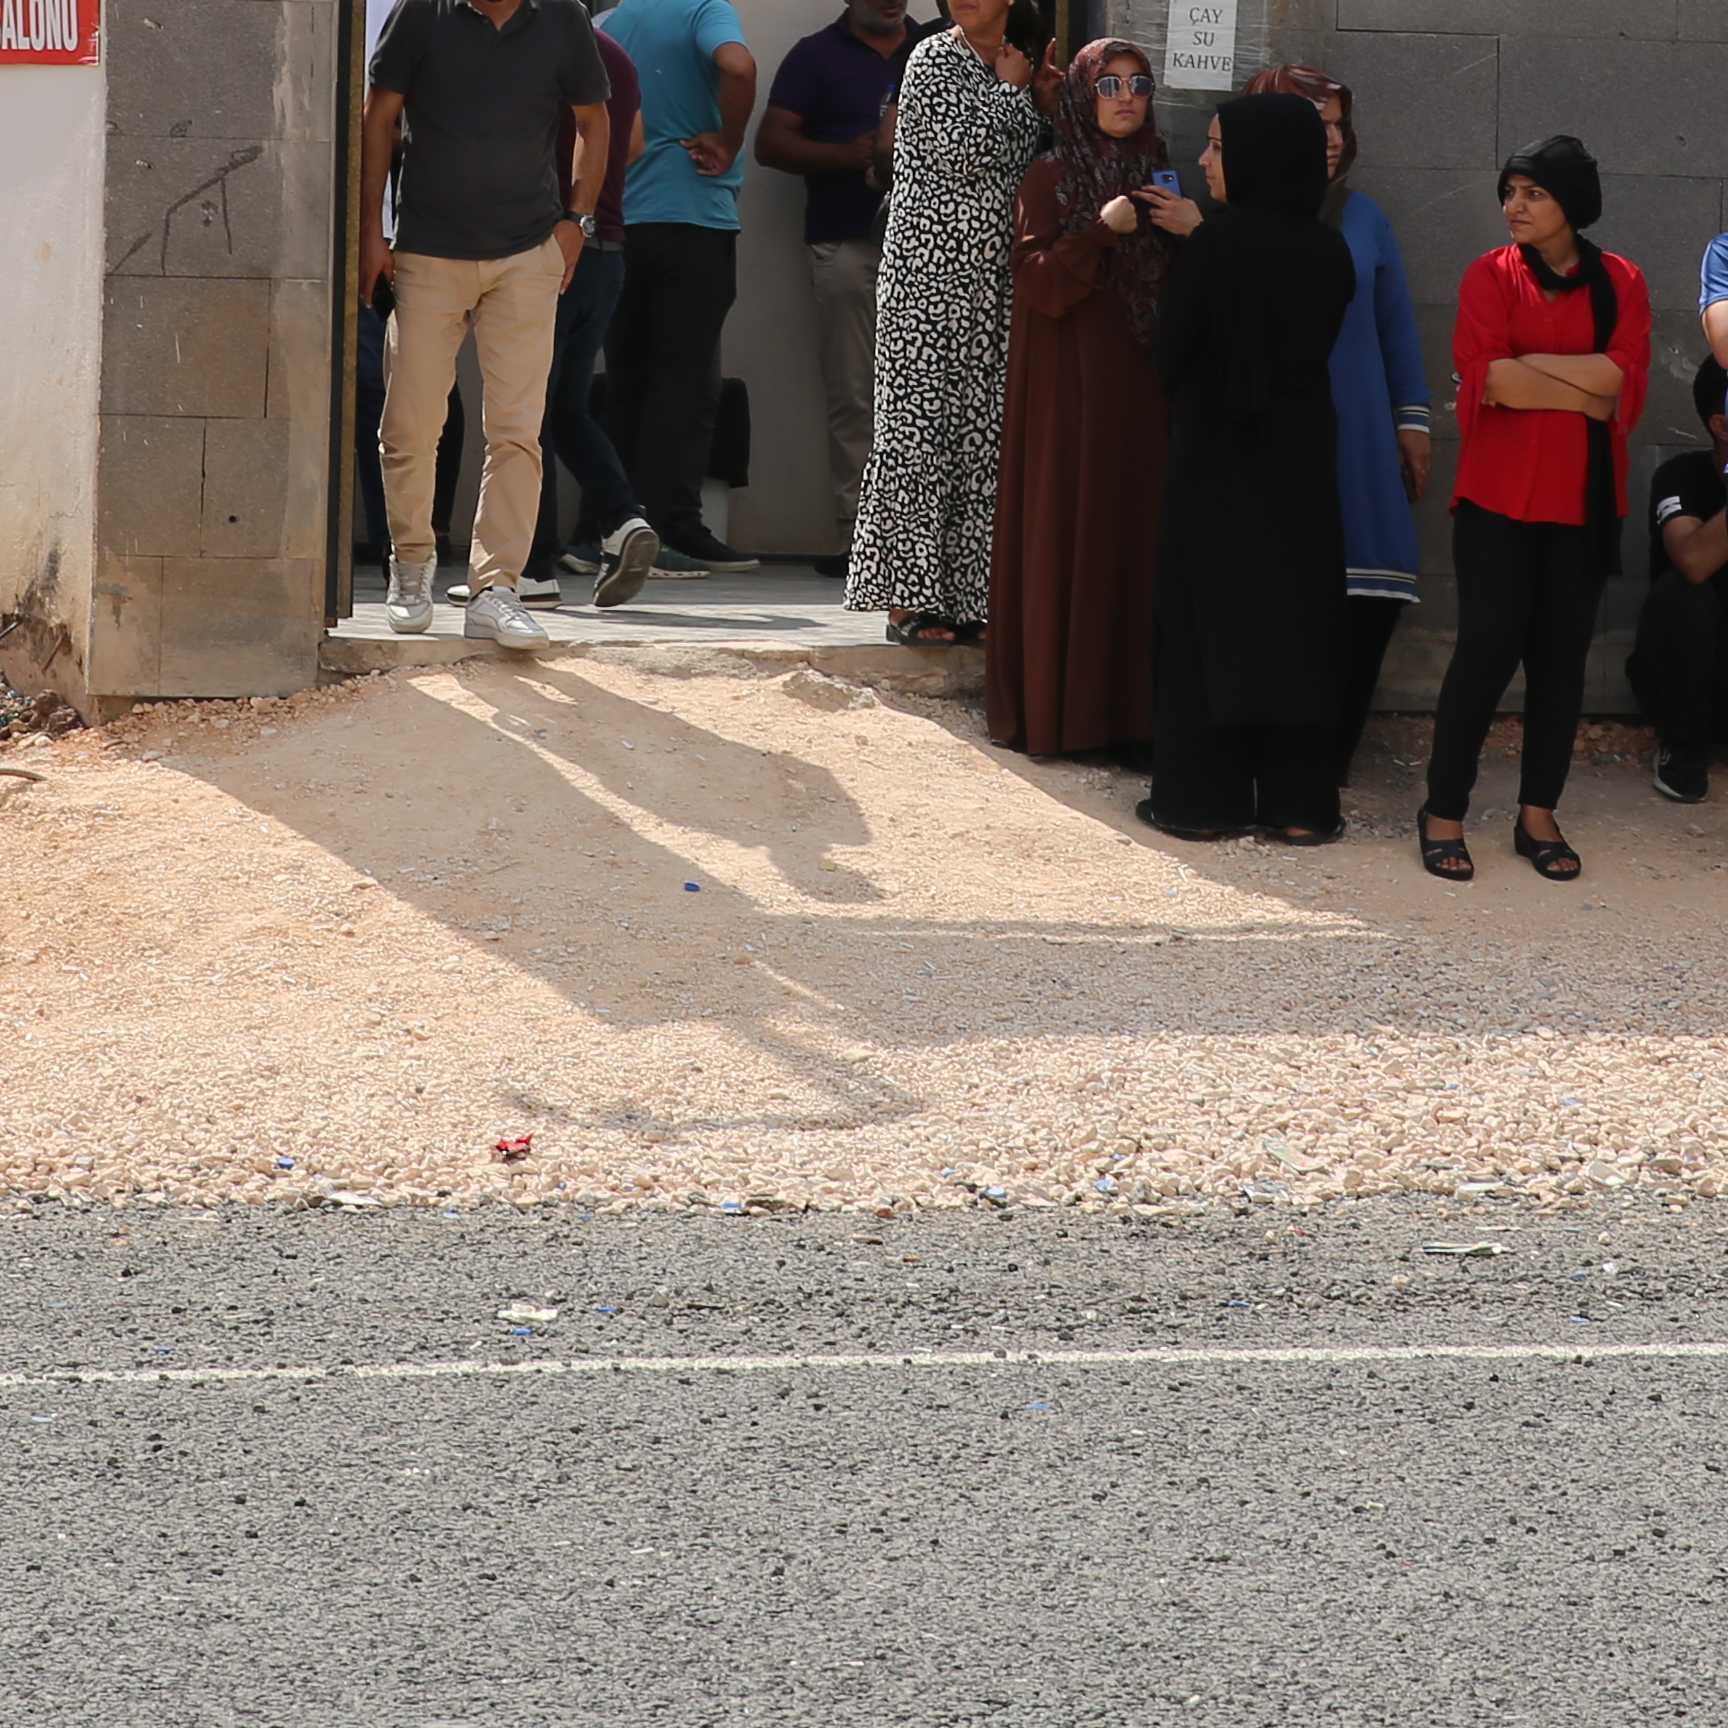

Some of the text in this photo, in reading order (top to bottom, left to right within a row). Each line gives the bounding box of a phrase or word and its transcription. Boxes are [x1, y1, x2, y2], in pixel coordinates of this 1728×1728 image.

[1189, 7, 1223, 26] ÇAY
[1193, 31, 1215, 47] SU
[1172, 53, 1233, 72] KAHVE
